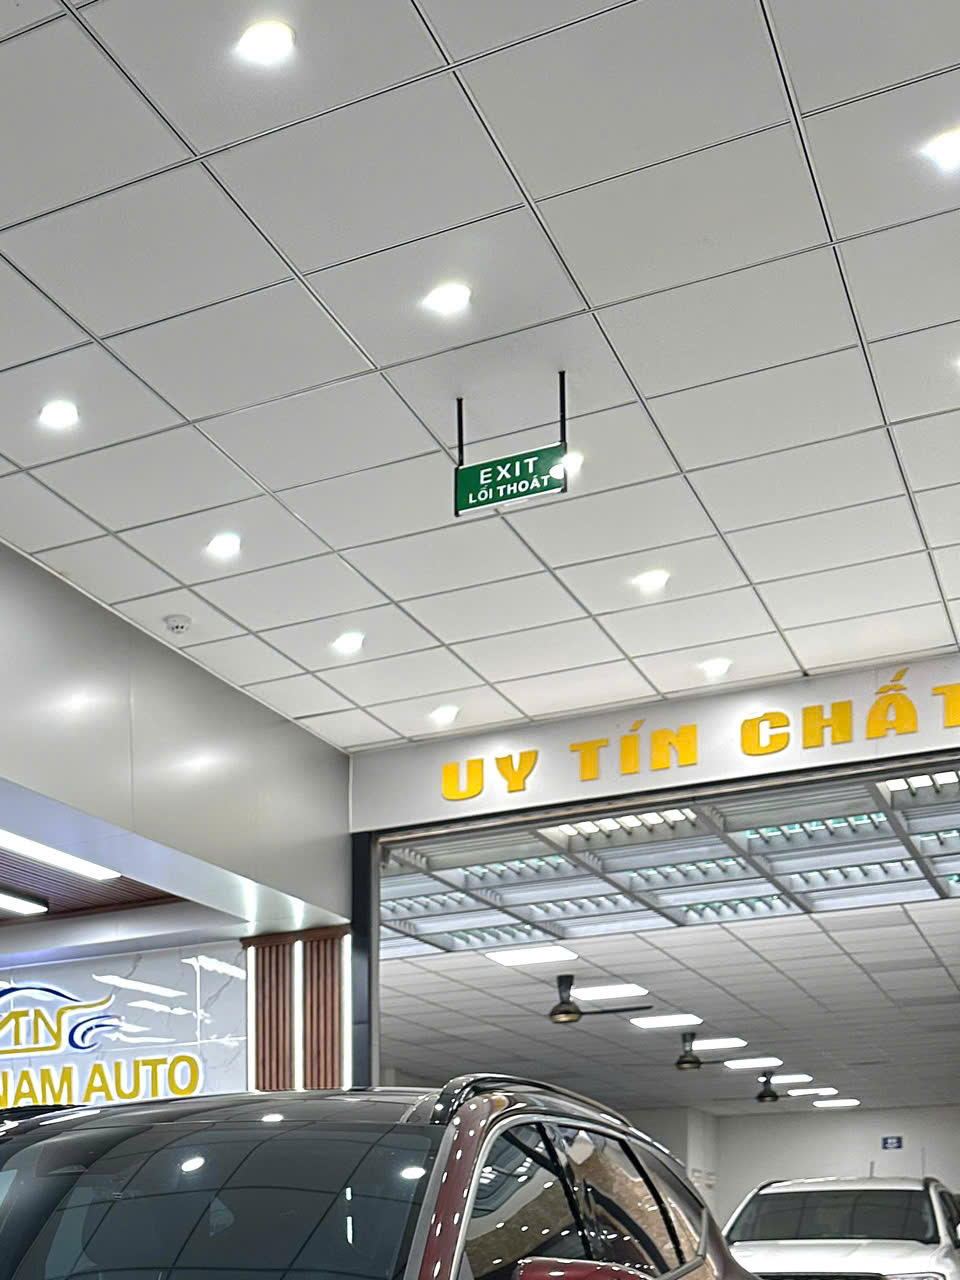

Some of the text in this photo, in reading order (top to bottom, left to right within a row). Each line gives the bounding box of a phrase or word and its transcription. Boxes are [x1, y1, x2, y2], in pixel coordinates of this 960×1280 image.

[468, 474, 551, 504] LỐI THOÁT
[480, 457, 539, 485] EXIT
[441, 667, 960, 801] UY TÍN CHẤT
[83, 1055, 201, 1103] AUTO
